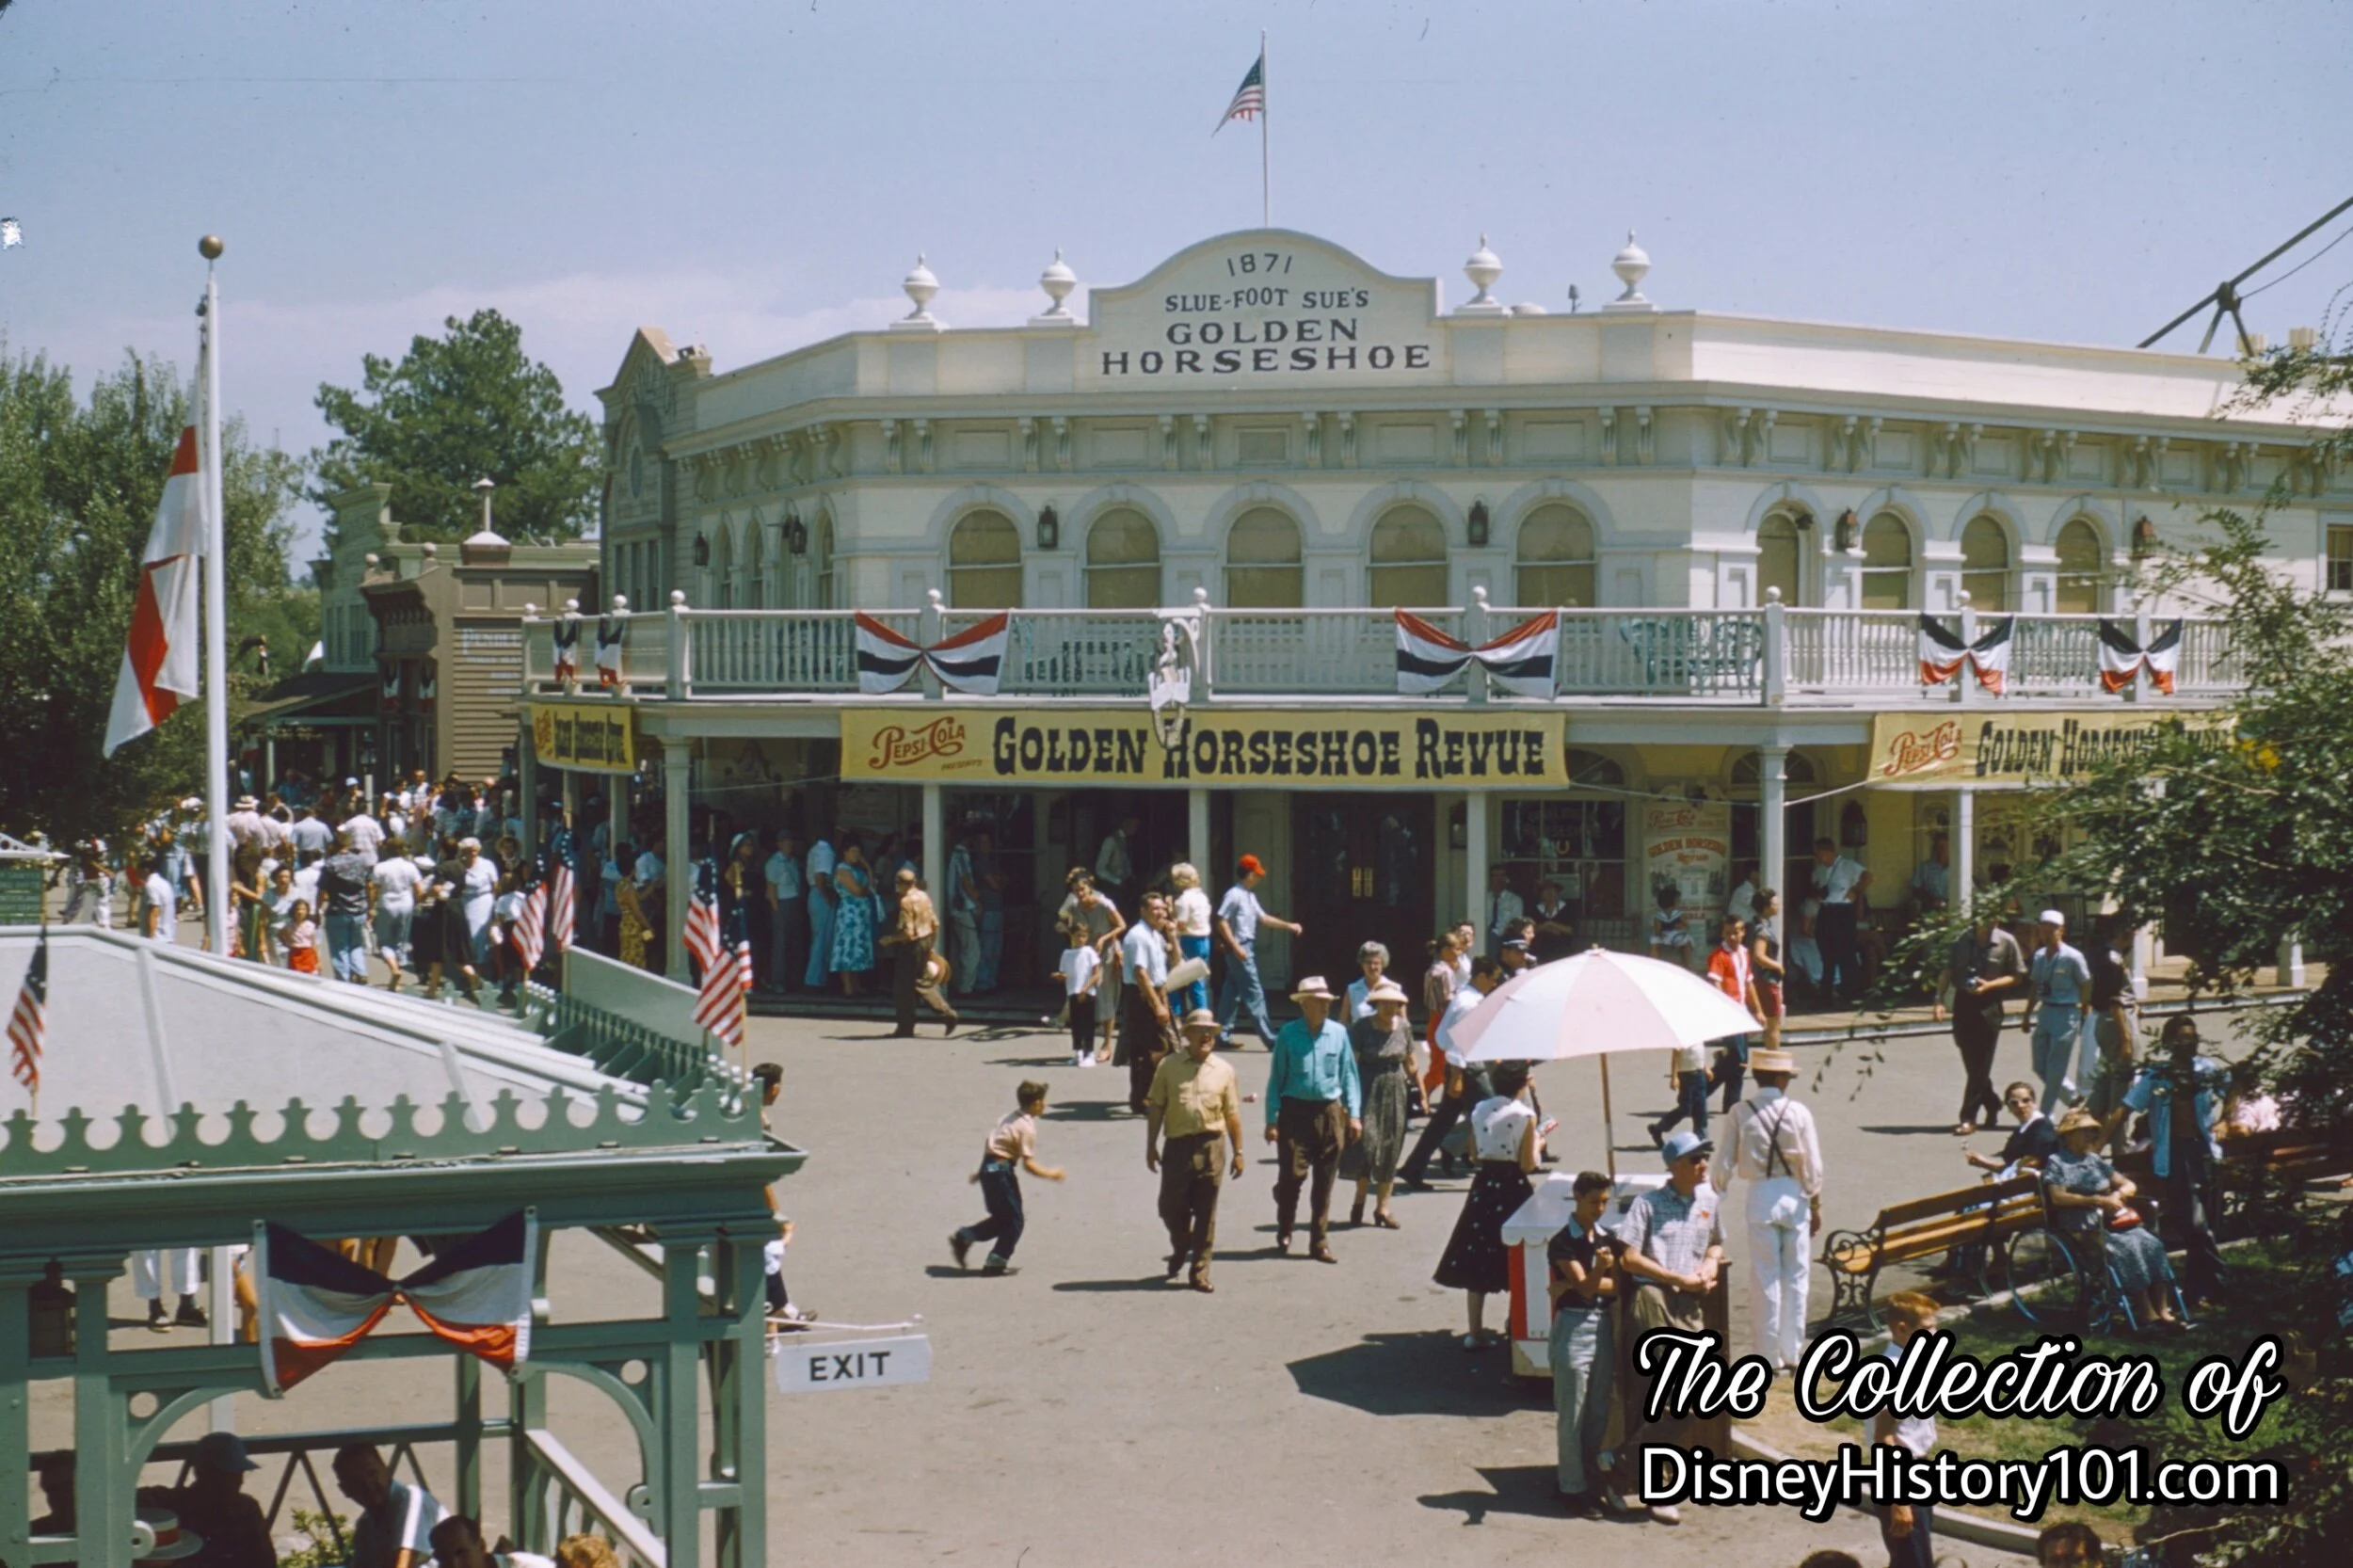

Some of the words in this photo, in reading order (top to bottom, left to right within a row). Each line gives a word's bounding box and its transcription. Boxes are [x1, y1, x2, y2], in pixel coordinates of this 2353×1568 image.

[1226, 252, 1292, 277] 1871
[1164, 286, 1289, 312] SLUE-FOOT
[1302, 286, 1369, 310] SUE'S
[1166, 318, 1358, 346] GOLDEN
[1101, 344, 1431, 376] HORSESHOE
[993, 716, 1148, 776] GOLDEN
[1162, 717, 1401, 779] HORSESHOE
[1415, 717, 1545, 779] REVUE
[1976, 720, 2056, 777] GOLDEN
[809, 1351, 891, 1382] EXIT
